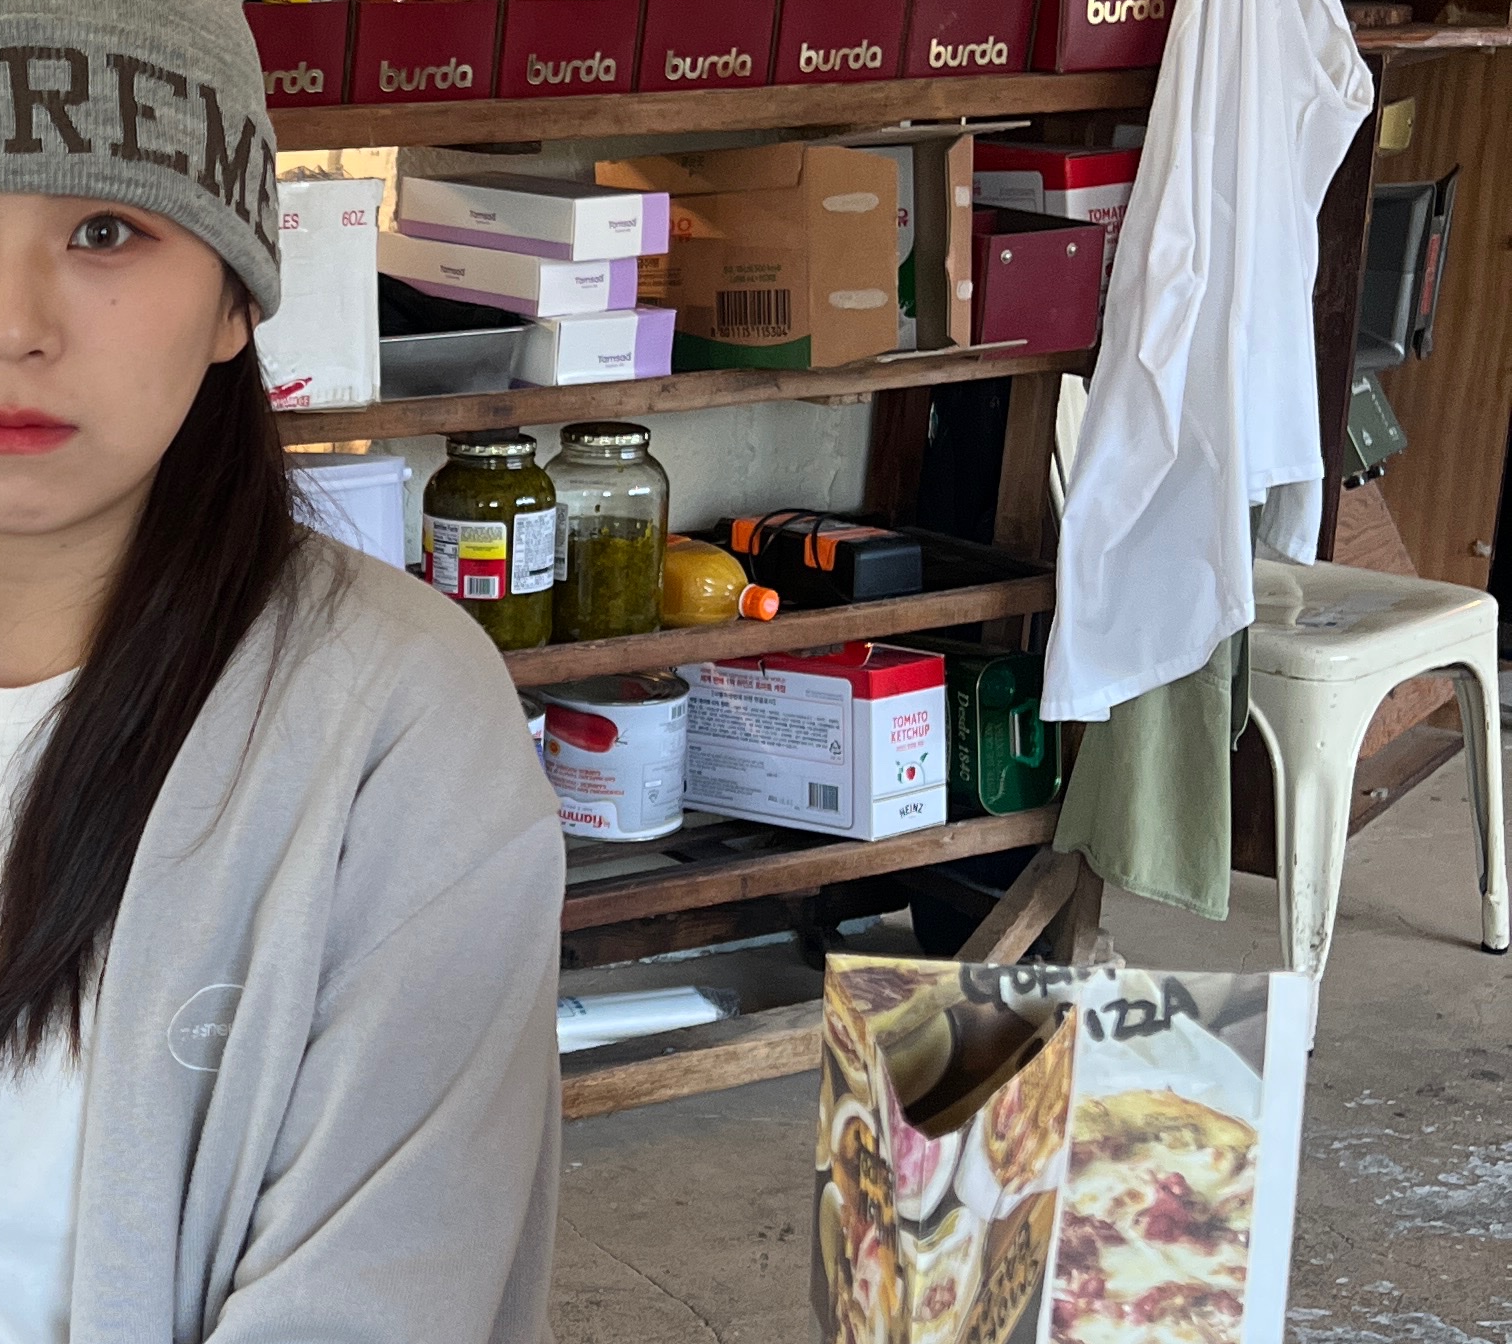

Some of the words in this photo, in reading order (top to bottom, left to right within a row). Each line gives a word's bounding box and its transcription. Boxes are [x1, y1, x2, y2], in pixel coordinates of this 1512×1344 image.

[664, 47, 752, 81] burda
[799, 39, 883, 73] burda
[928, 35, 1008, 68] burda
[379, 56, 473, 92] burda
[526, 52, 617, 86] burda
[890, 723, 931, 744] KETCHUP
[892, 710, 928, 729] TOMATO
[957, 691, 970, 742] Desde
[958, 742, 971, 782] 1840
[557, 809, 603, 829] fiamm
[899, 802, 924, 818] HEINZ
